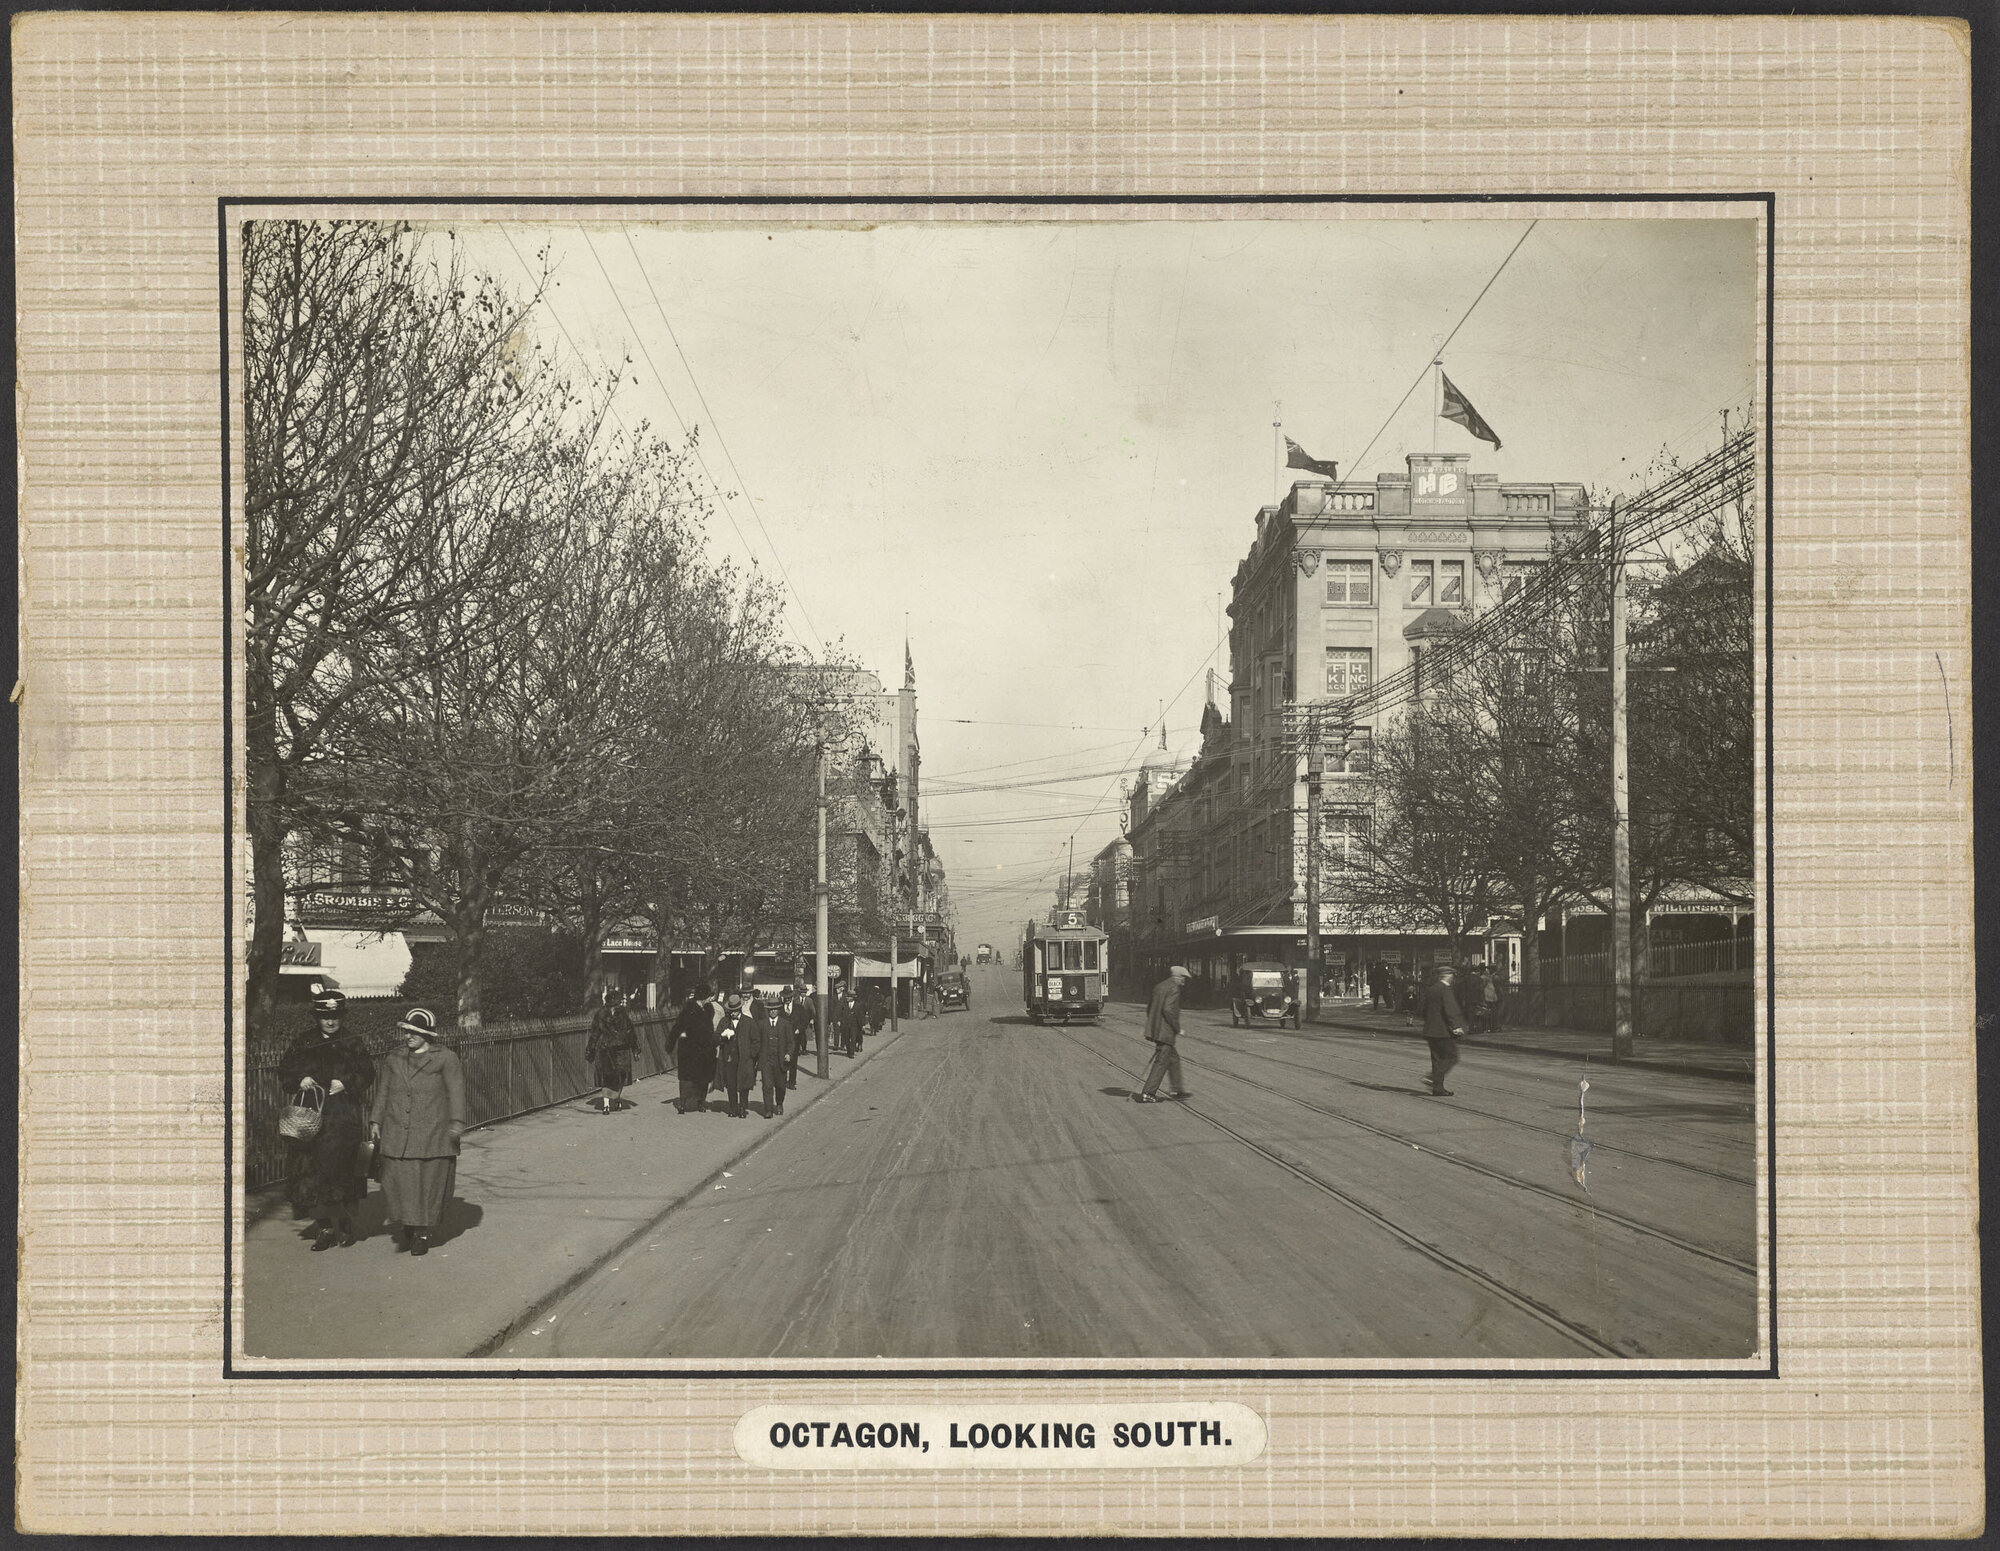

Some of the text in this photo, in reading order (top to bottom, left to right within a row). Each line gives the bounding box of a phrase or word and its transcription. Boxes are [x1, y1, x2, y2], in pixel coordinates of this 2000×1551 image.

[1351, 664, 1367, 673] H.
[1328, 674, 1367, 683] KING
[1068, 913, 1077, 925] 5
[606, 939, 622, 947] Lace
[623, 939, 642, 947] House
